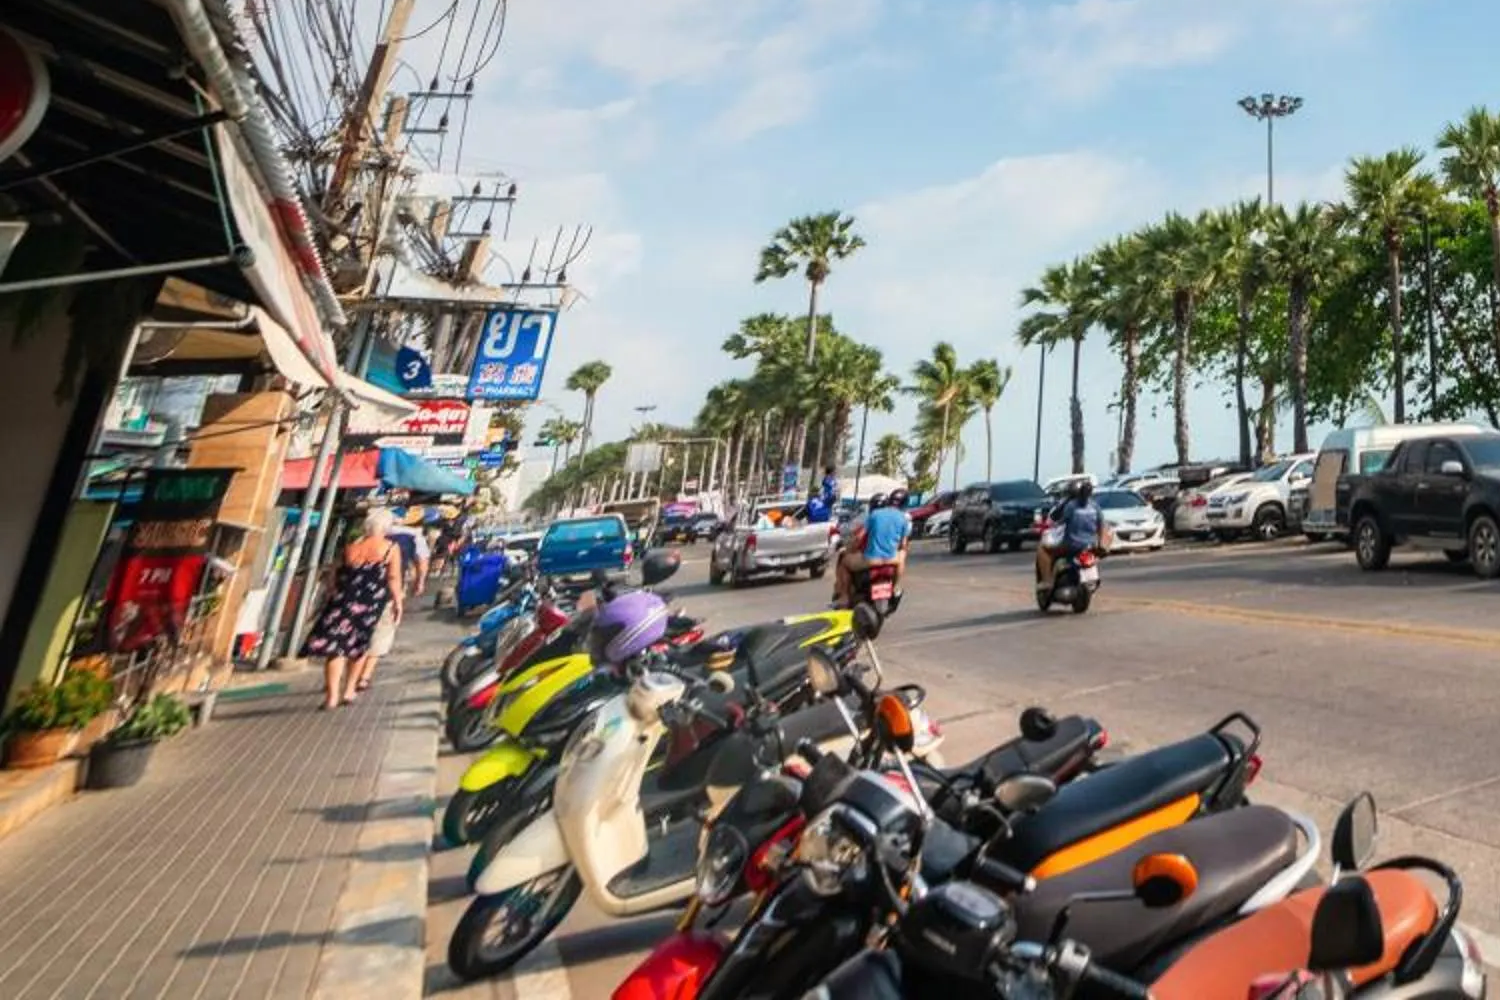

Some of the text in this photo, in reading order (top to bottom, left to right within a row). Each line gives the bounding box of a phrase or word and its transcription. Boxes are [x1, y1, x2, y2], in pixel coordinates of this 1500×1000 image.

[483, 312, 551, 359] ยา
[402, 359, 421, 380] 3
[485, 385, 537, 397] PHARMACY
